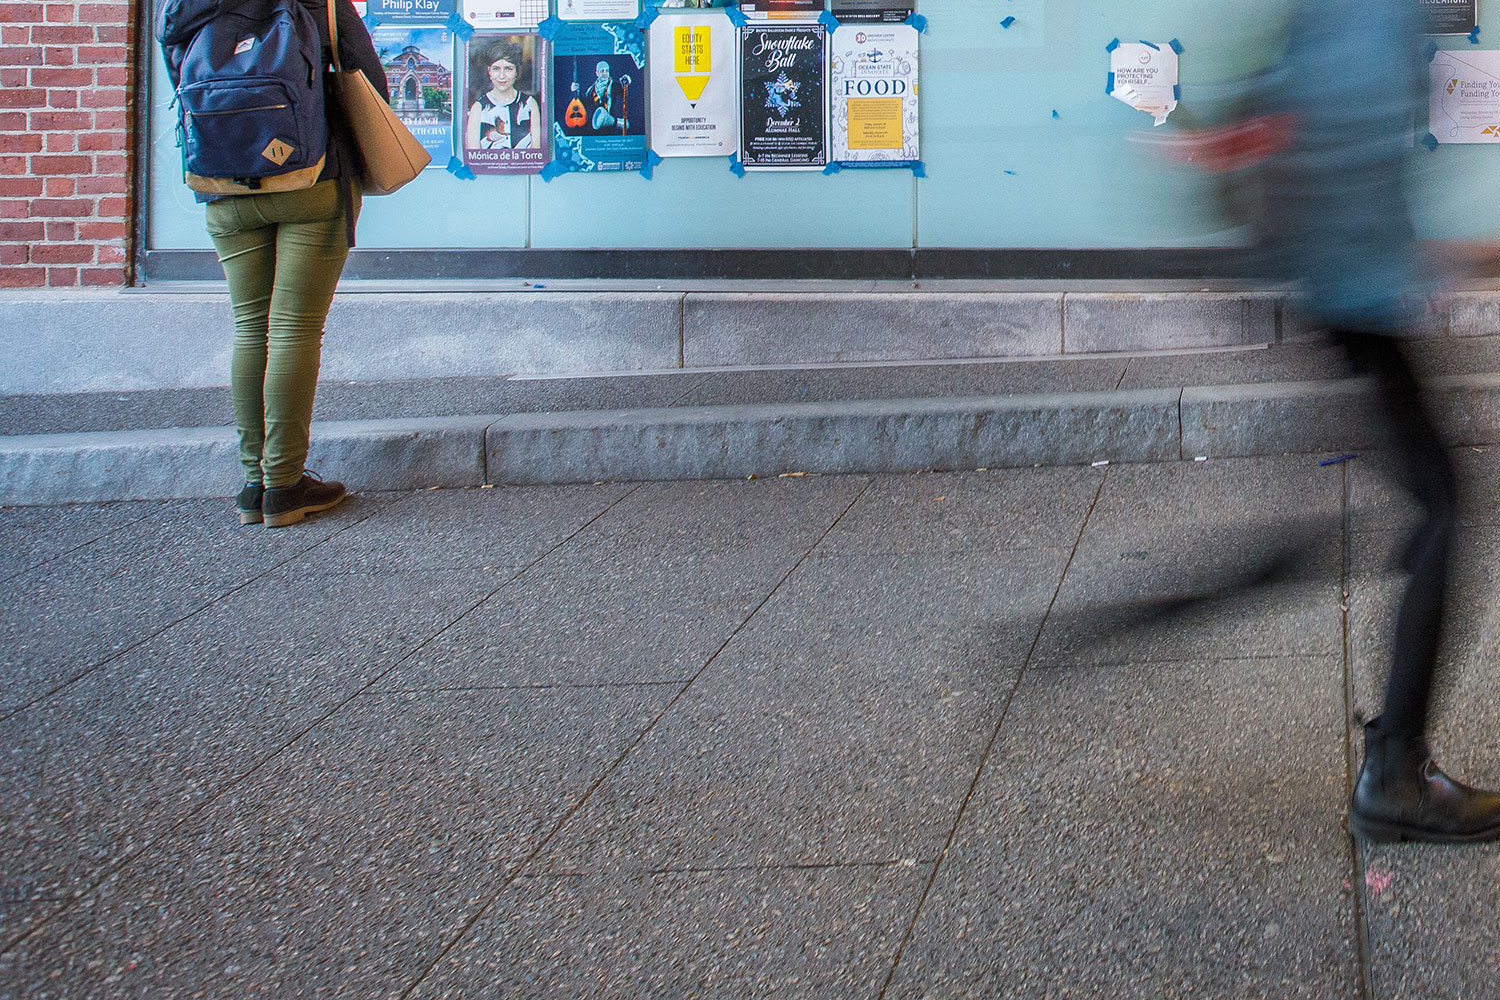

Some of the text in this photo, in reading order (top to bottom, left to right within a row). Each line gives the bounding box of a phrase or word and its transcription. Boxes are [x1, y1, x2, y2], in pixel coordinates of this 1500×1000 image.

[382, 0, 440, 11] Philip Klay
[682, 34, 702, 43] EQUITY
[752, 32, 815, 56] Snowflake
[681, 45, 703, 54] STARTS
[685, 56, 700, 65] HERE
[765, 50, 797, 72] Ball
[844, 79, 906, 96] FOOD
[1460, 81, 1487, 90] Finding
[1460, 90, 1489, 98] Funding
[766, 117, 794, 128] December
[468, 151, 542, 160] Mónica de la Torre
